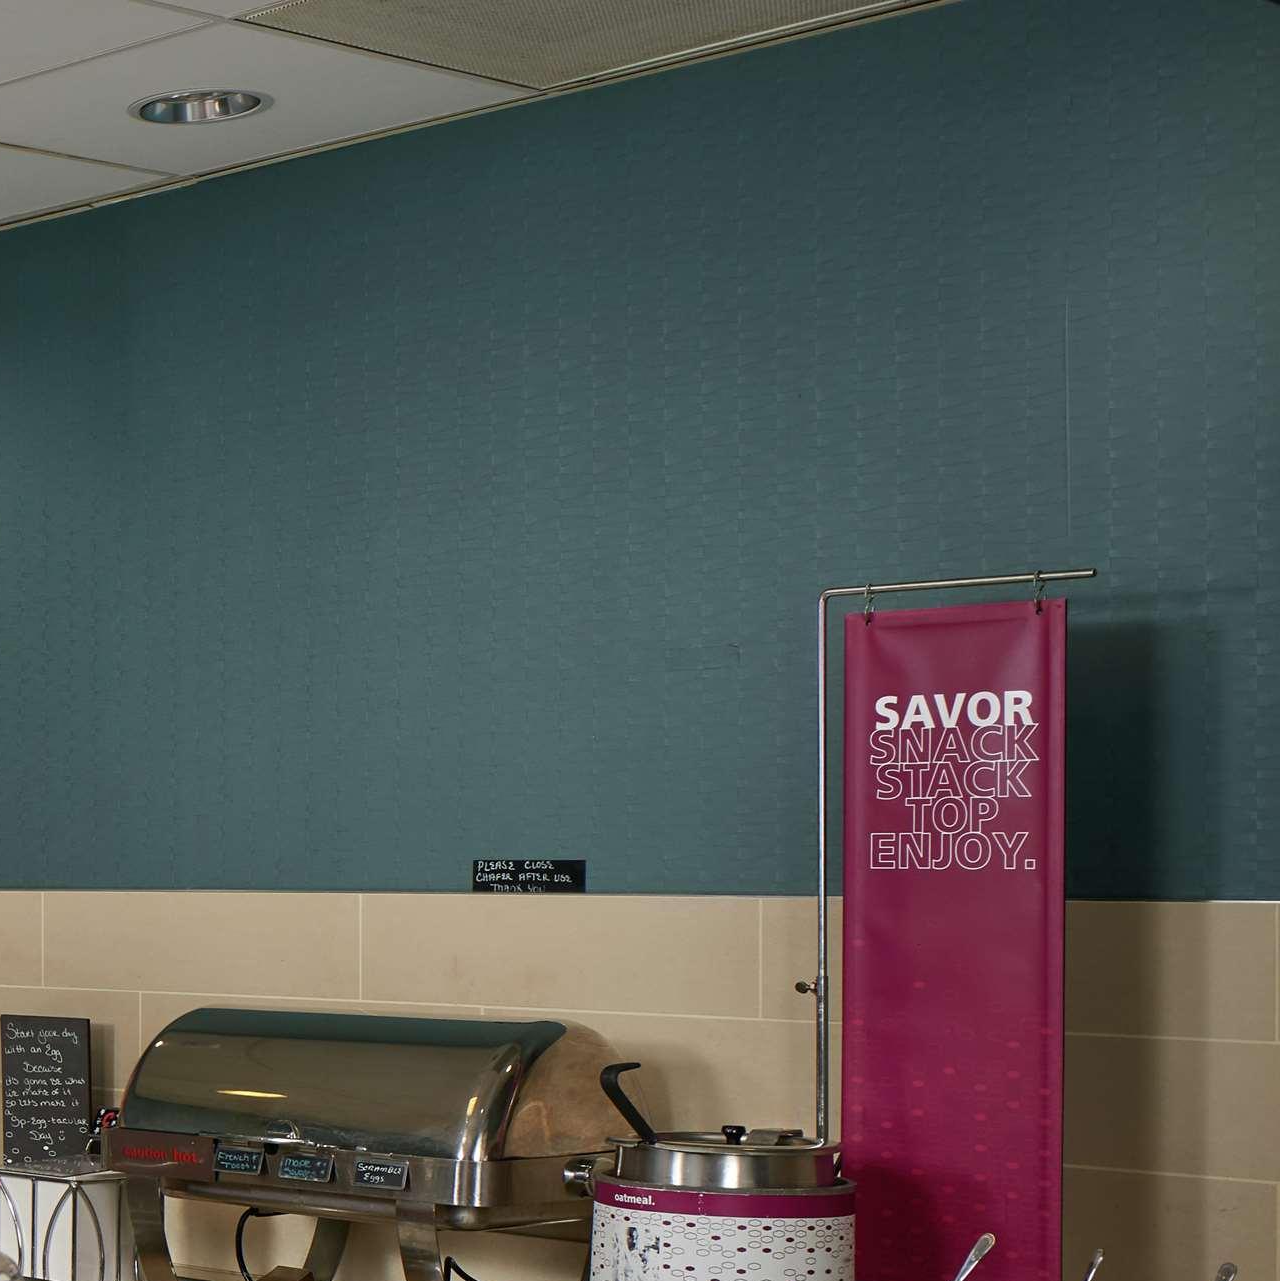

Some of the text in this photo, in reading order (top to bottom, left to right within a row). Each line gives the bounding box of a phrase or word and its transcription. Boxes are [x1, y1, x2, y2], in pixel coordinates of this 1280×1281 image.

[874, 690, 1034, 730] SAVOR
[869, 722, 1040, 766] SNACK
[875, 760, 1033, 800] STACK
[904, 796, 1000, 834] TOP
[477, 860, 555, 872] PLEASE CLOSE
[869, 831, 1037, 871] ENJOY.
[518, 872, 550, 882] AFTER
[553, 873, 573, 883] USE
[4, 1045, 26, 1055] with
[30, 1046, 42, 1054] an
[614, 1192, 656, 1207] oatmeal.
